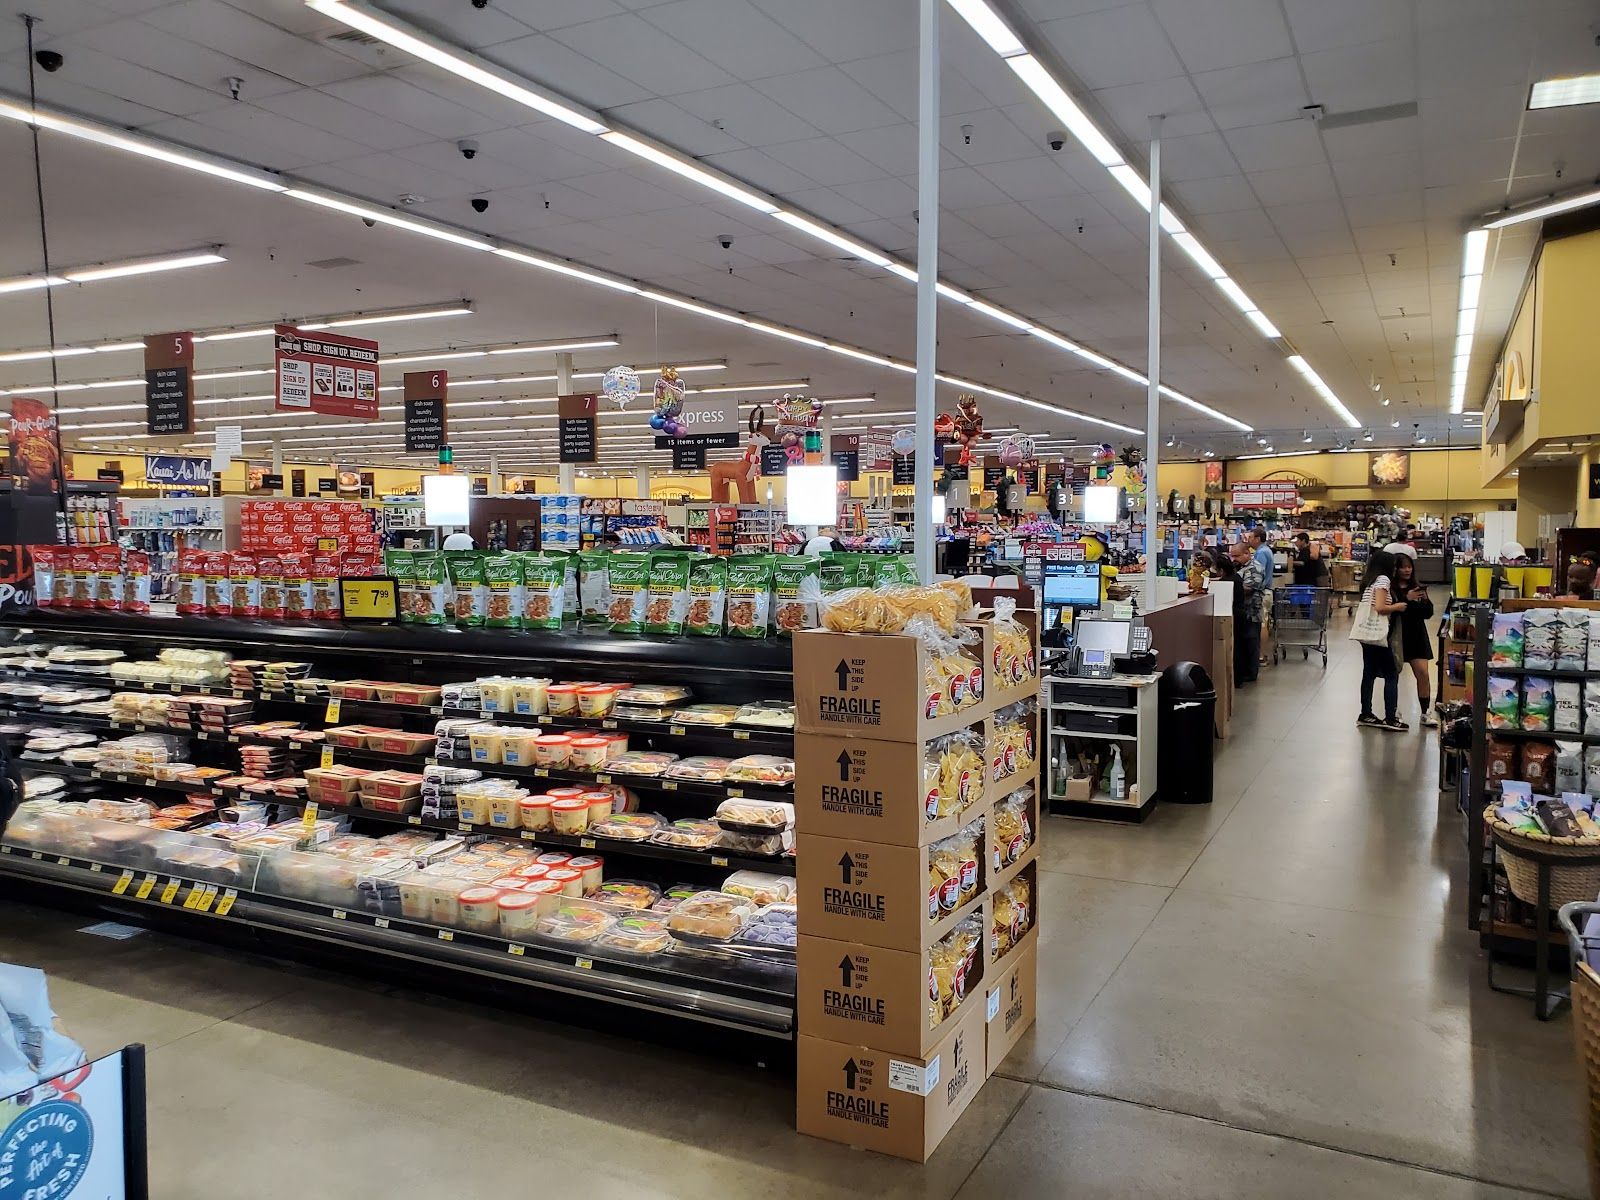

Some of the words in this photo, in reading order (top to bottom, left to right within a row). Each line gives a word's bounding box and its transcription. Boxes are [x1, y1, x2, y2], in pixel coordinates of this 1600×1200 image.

[175, 338, 182, 354] 5
[304, 342, 322, 352] SHOP.
[323, 345, 338, 356] SIGN
[340, 348, 348, 357] UP.
[350, 350, 376, 361] REDEEM.
[283, 362, 298, 370] SHOP
[283, 375, 297, 383] SIGN
[432, 375, 439, 388] 6
[283, 388, 306, 397] REDEEM
[584, 398, 590, 408] 7
[676, 410, 724, 428] xpress
[849, 437, 857, 445] 10
[173, 460, 193, 480] As
[953, 488, 958, 497] 1
[1011, 492, 1018, 502] 2
[1058, 494, 1066, 504] 3
[1128, 498, 1134, 506] 5
[1176, 500, 1182, 508] 7
[254, 502, 275, 512] Coca-Cola
[284, 502, 304, 511] Coca-Cola
[312, 502, 332, 512] Coca-Cola
[340, 503, 358, 512] Coca-Cola
[263, 513, 284, 522] Coca-Cola
[293, 513, 313, 522] Coca-Cola
[321, 513, 342, 522] Coca-Cola
[349, 514, 368, 522] Coca-Cola
[264, 524, 285, 533] Coca-Cola
[294, 524, 314, 533] Coca-Cola
[322, 524, 342, 533] Coca-Cola
[350, 524, 368, 533] Coca-Cola
[273, 535, 294, 545] Coca-Cola
[356, 535, 374, 544] Coca-Cola
[820, 696, 880, 715] FRAGILE
[820, 713, 845, 722] HANDLE
[846, 716, 862, 724] WITH
[864, 717, 880, 725] CARE
[822, 785, 882, 806] FRAGILE
[822, 803, 846, 813] HANDLE
[848, 806, 864, 815] WITH
[866, 807, 883, 817] CARE
[824, 888, 884, 910] FRAGILE
[824, 905, 848, 915] HANDLE
[850, 908, 866, 918] WITH
[868, 912, 885, 922] CARE
[824, 989, 884, 1015] FRAGILE
[824, 1007, 848, 1018] HANDLE
[850, 1012, 866, 1022] WITH
[868, 1015, 885, 1026] CARE
[860, 1068, 872, 1076] THIS
[860, 1077, 872, 1085] SIDE
[948, 1060, 968, 1098] FRAGILE
[828, 1091, 889, 1118] FRAGILE
[827, 1107, 852, 1120] HANDLE
[854, 1113, 870, 1125] WITH
[872, 1118, 889, 1128] CARE
[0, 1112, 77, 1189] PERFECTING
[30, 1140, 48, 1156] the
[26, 1152, 51, 1181] Art
[22, 1154, 81, 1200] FRESH
